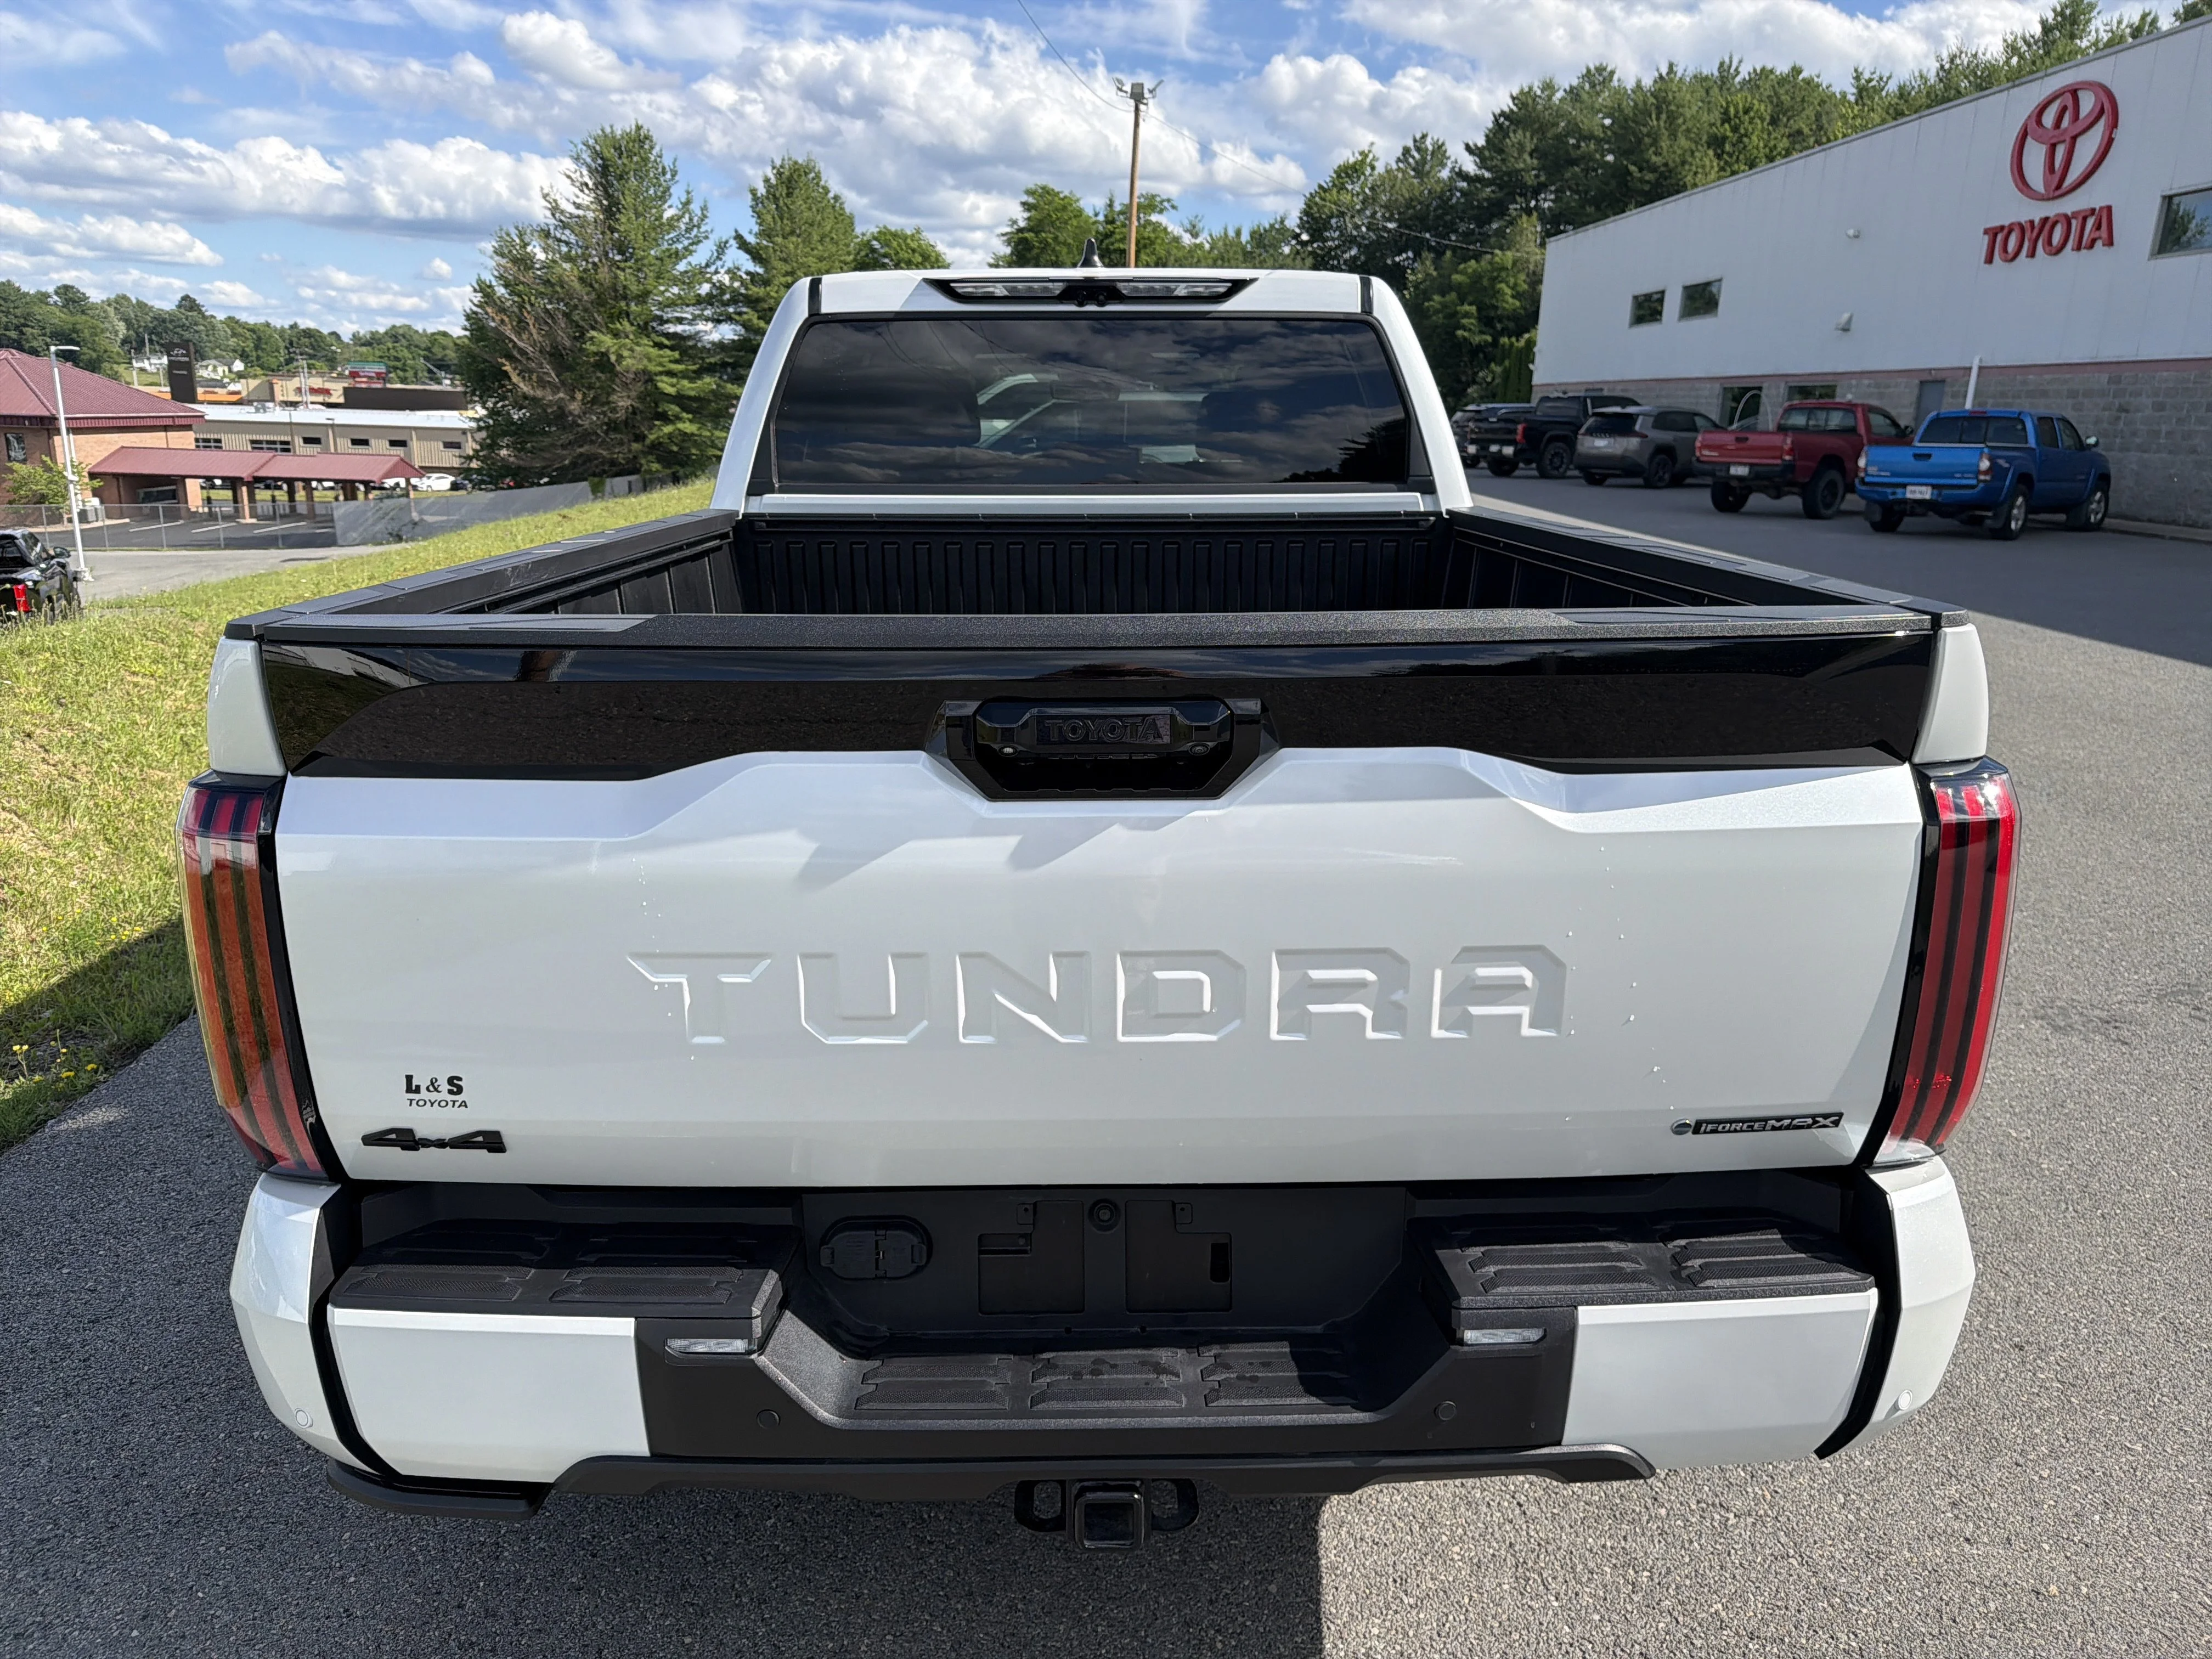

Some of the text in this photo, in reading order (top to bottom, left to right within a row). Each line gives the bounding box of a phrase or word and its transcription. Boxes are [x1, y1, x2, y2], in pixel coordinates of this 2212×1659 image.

[1983, 205, 2114, 264] TOYOTA
[1045, 717, 1164, 743] TOYOTA
[625, 944, 1568, 1046] TUNDRA
[405, 1074, 464, 1096] L & S
[407, 1098, 469, 1109] TOYOTA
